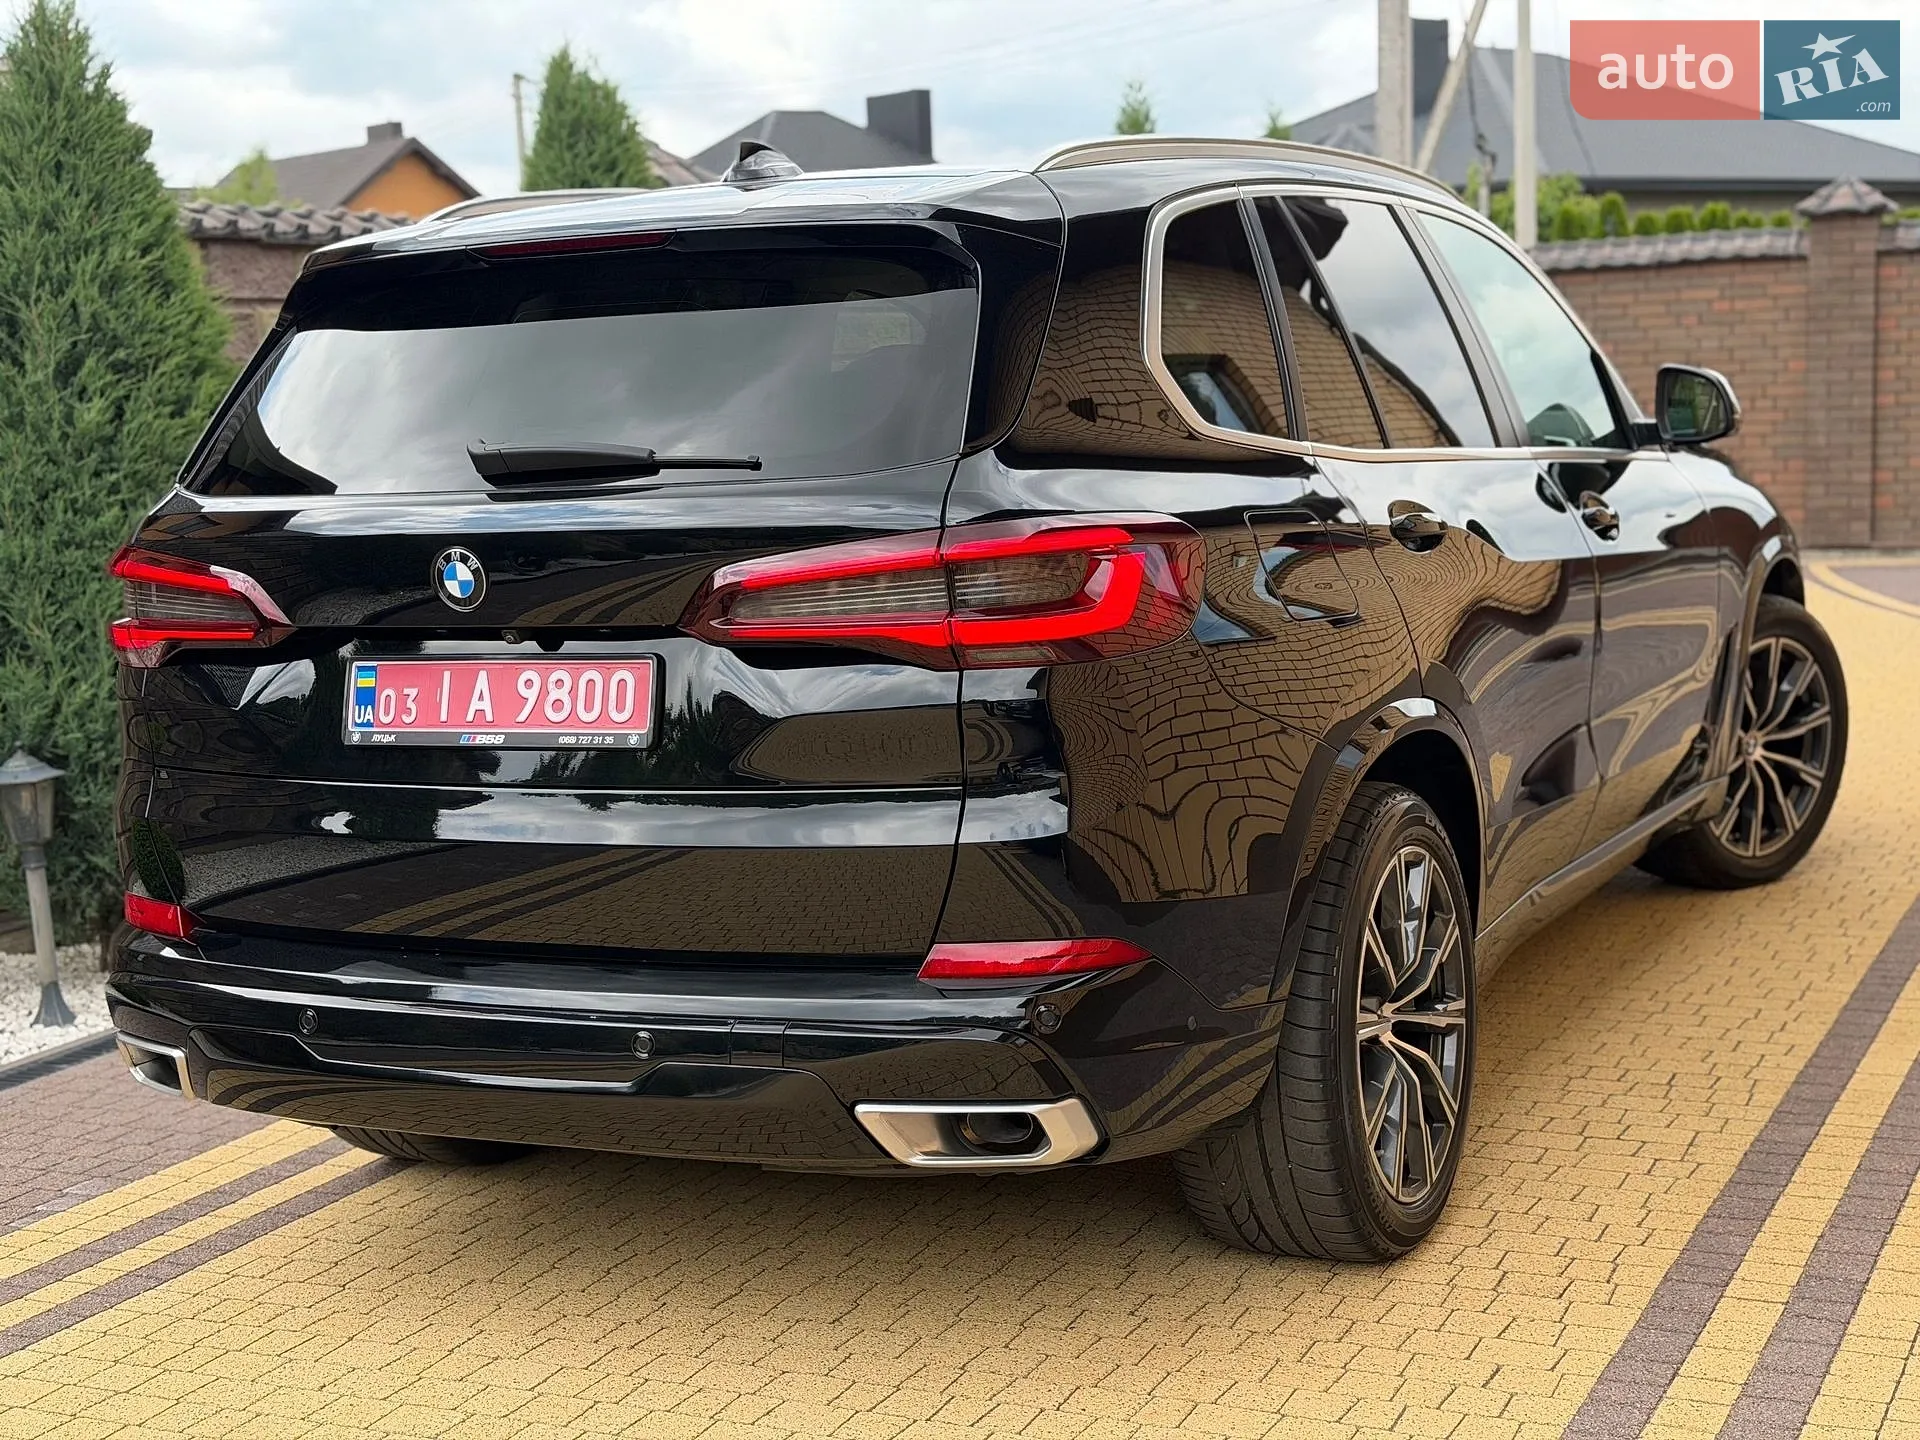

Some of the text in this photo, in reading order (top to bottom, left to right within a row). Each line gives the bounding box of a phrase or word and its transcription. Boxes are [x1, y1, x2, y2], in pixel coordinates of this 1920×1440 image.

[438, 551, 479, 571] BMW
[379, 687, 419, 724] 03
[514, 668, 636, 724] 9800
[353, 704, 375, 724] UA
[578, 735, 593, 745] 727
[593, 735, 603, 745] 31
[603, 735, 615, 745] 35
